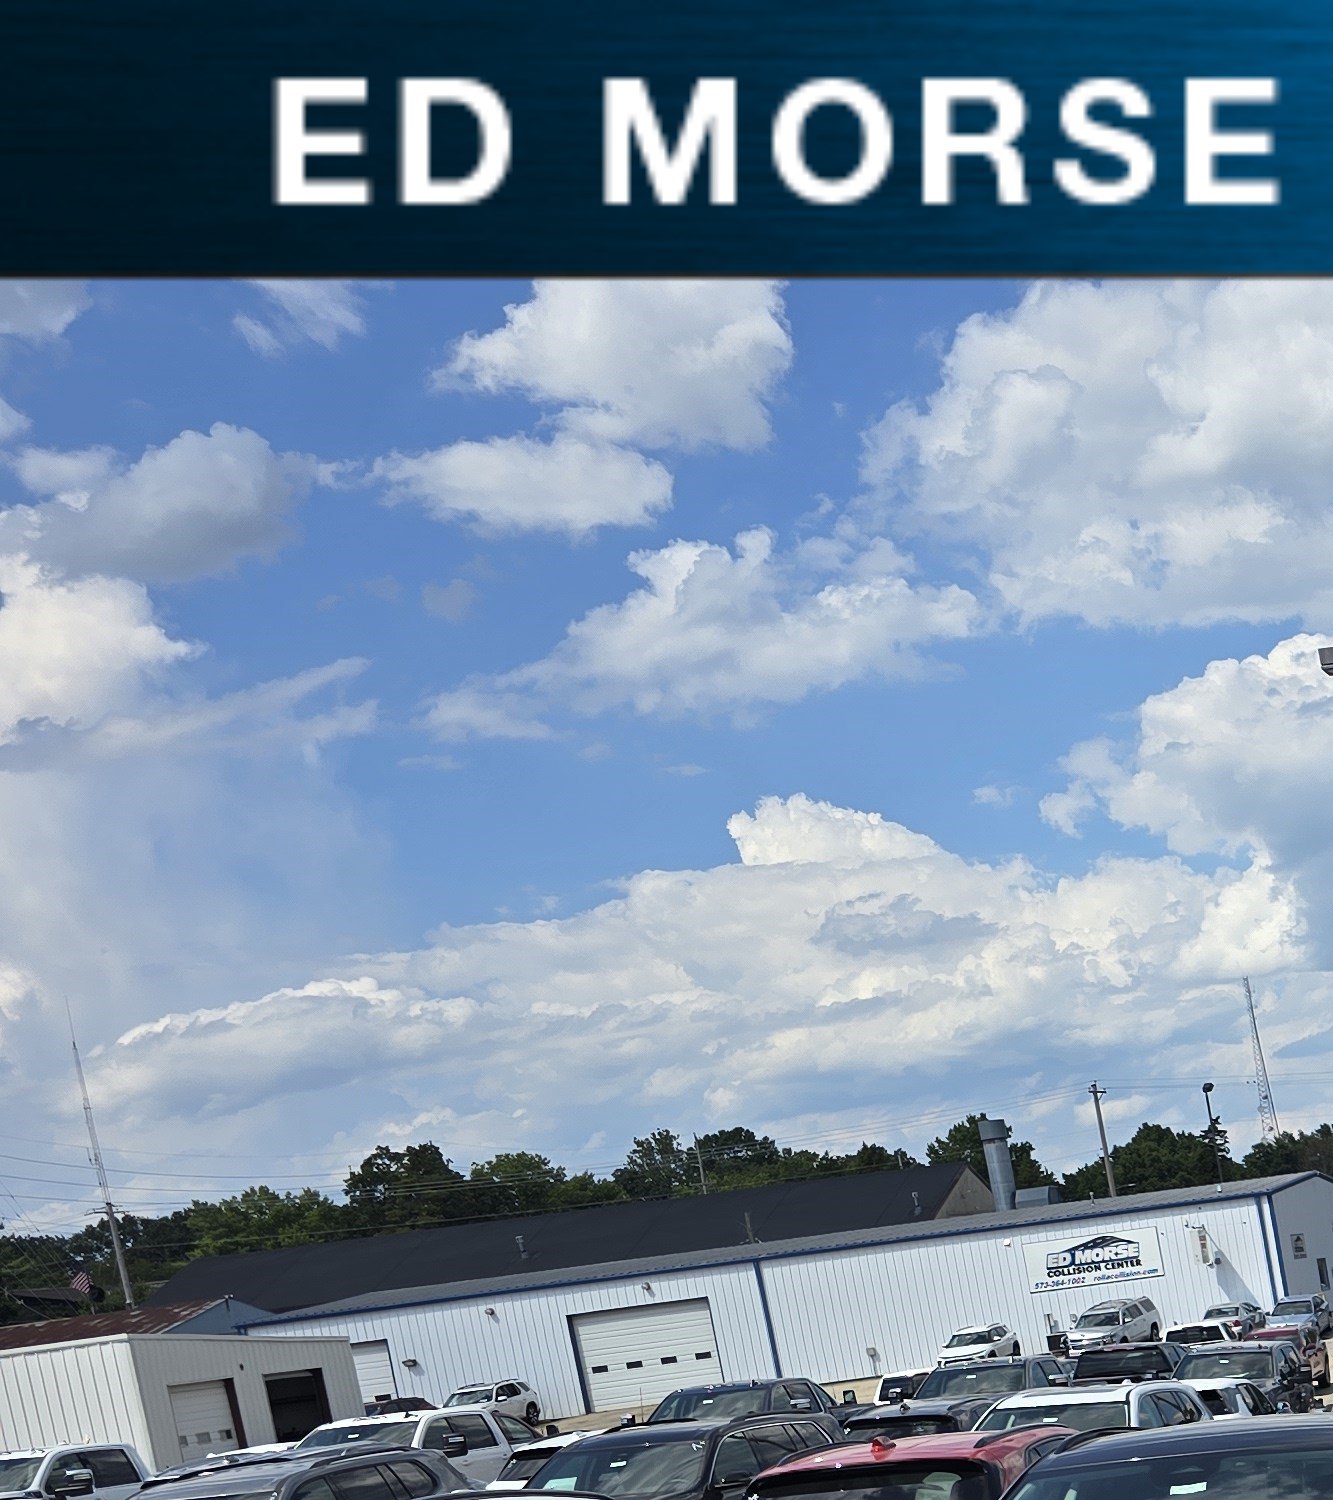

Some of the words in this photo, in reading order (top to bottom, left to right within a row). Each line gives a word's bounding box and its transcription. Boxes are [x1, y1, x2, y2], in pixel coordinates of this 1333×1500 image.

[1047, 1252, 1073, 1269] ED
[1074, 1242, 1140, 1265] MORSE
[1046, 1264, 1102, 1278] COLLISION
[1104, 1259, 1142, 1272] CENTER
[1034, 1276, 1086, 1290] 573-364-1002
